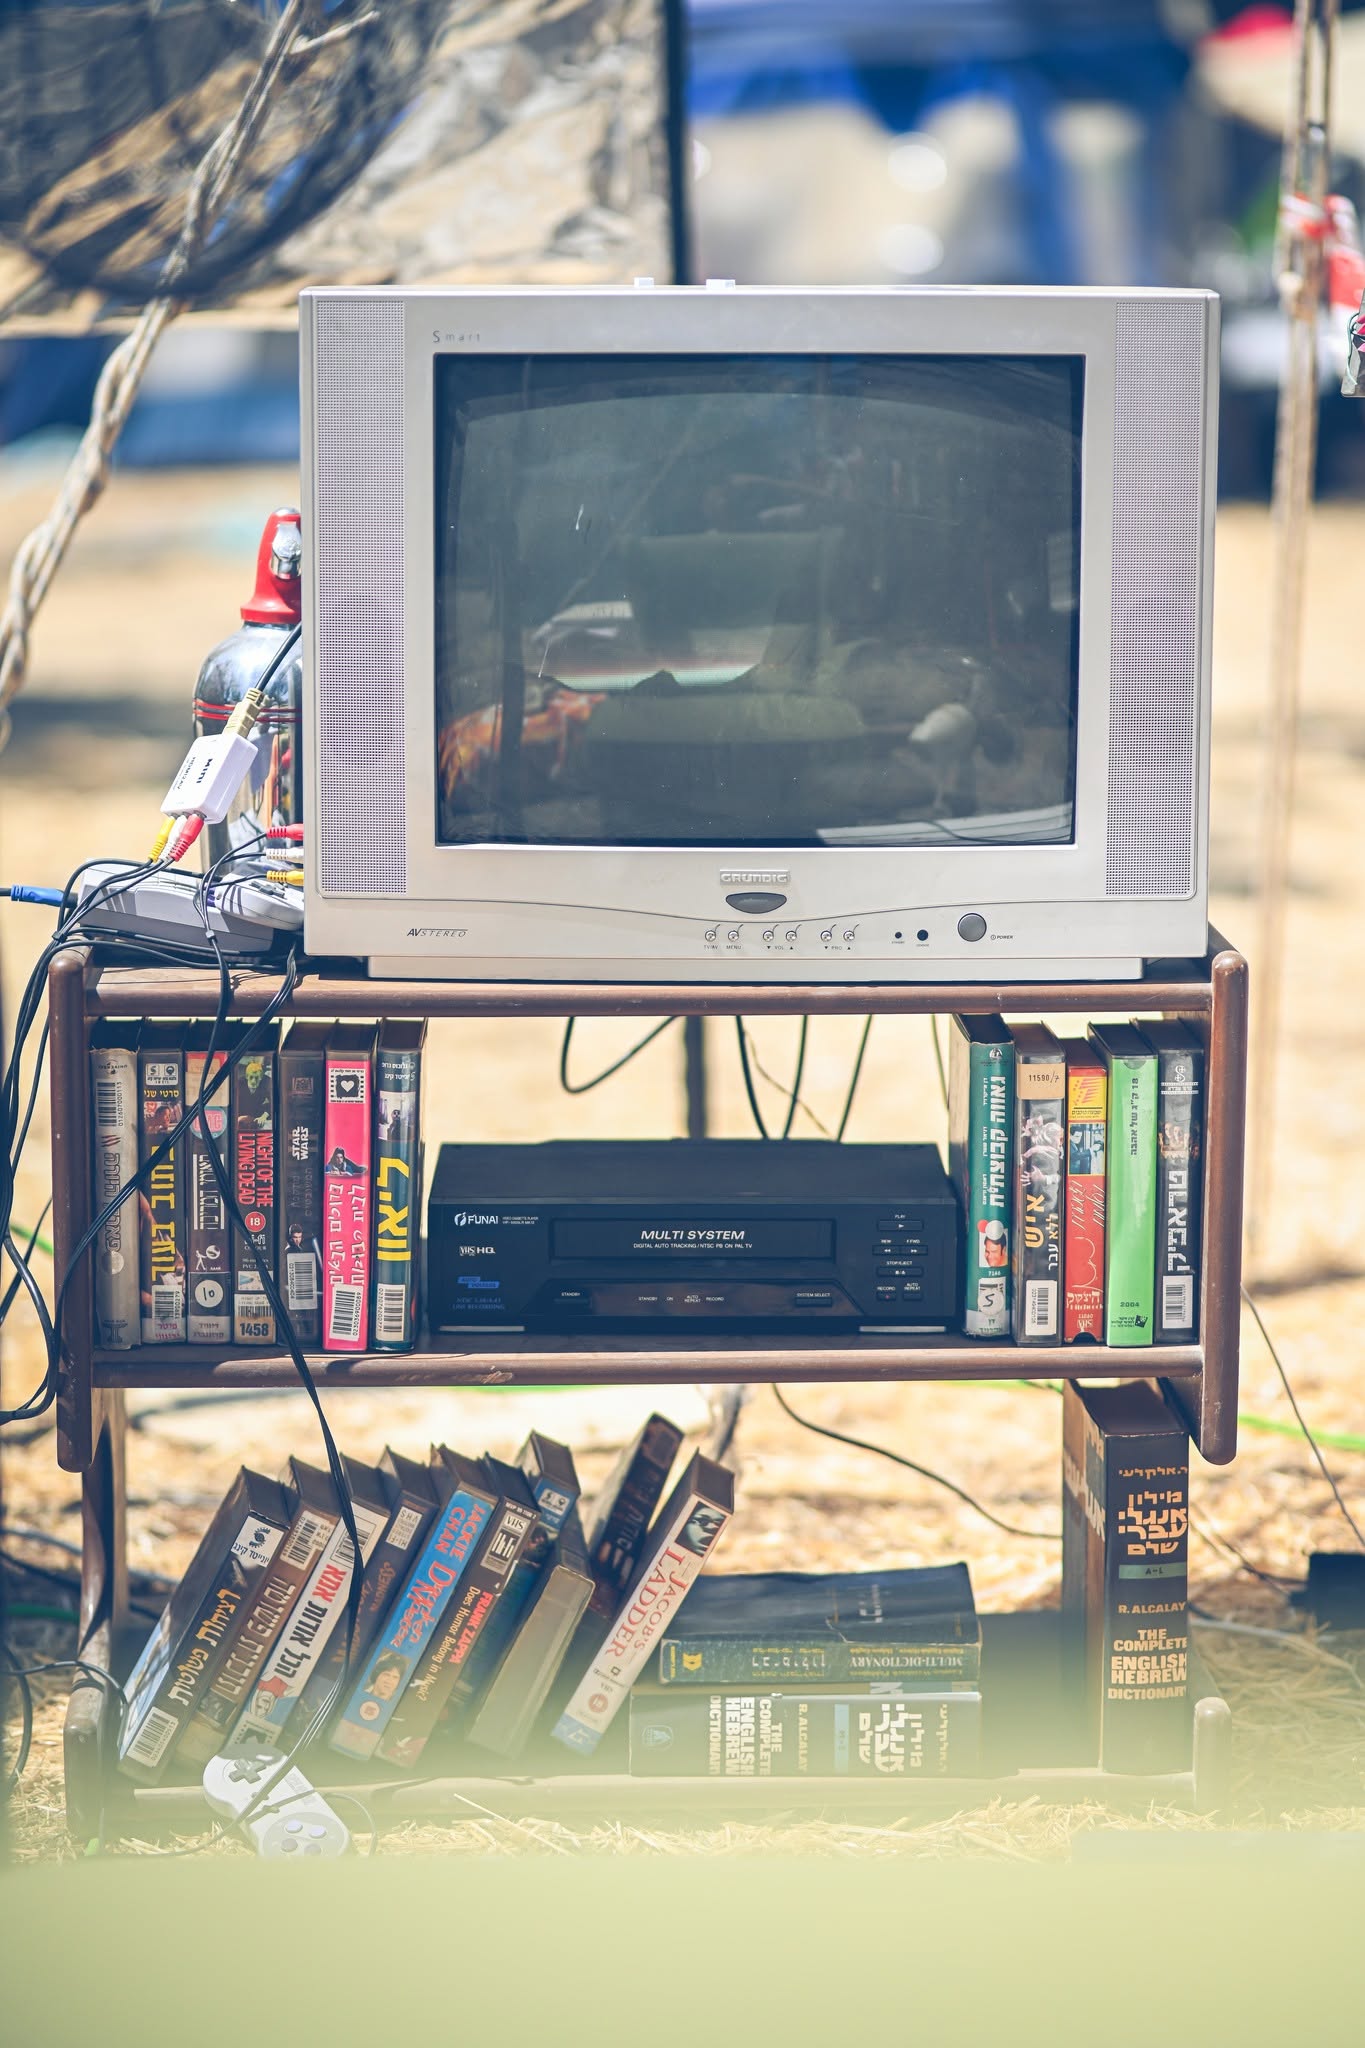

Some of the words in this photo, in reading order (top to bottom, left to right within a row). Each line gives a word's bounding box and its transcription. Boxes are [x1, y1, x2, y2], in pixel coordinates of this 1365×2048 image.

[720, 872, 788, 884] GRUNDIG
[143, 1089, 157, 1098] שני
[160, 1089, 180, 1098] סרטי
[1131, 1077, 1139, 1090] 18
[989, 1075, 1007, 1123] גאווה
[1129, 1112, 1138, 1127] של
[238, 1132, 255, 1170] LIVING
[257, 1132, 273, 1168] NIGHT
[291, 1125, 301, 1161] STAR
[300, 1126, 309, 1161] WARS
[1130, 1129, 1138, 1156] אהבה
[257, 1168, 273, 1183] OF
[988, 1128, 1009, 1208] קבוצתית
[238, 1172, 255, 1205] DEAD
[257, 1186, 273, 1208] THE
[347, 1183, 366, 1222] לבית
[250, 1217, 261, 1226] 18
[327, 1182, 345, 1233] ברוכים
[376, 1156, 412, 1262] ליאון
[467, 1213, 499, 1225] FUNAI
[1024, 1193, 1045, 1248] איש
[1167, 1169, 1191, 1273] טראפיק
[640, 1230, 684, 1241] MULTI
[686, 1230, 746, 1241] SYSTEM
[1045, 1213, 1059, 1240] ללא
[327, 1239, 346, 1285] הבאים
[476, 1246, 496, 1254] HQ
[1048, 1243, 1059, 1271] עבר
[202, 1287, 216, 1302] 10
[240, 1322, 269, 1337] 1458
[1128, 1490, 1183, 1509] מילון
[432, 1506, 466, 1554] CHAN
[504, 1514, 526, 1531] VHS
[1118, 1507, 1188, 1526] אנגלי
[1118, 1522, 1188, 1540] עברי
[450, 1503, 487, 1561] JACKIE
[1127, 1541, 1179, 1556] שלם
[311, 1563, 348, 1604] אמא
[462, 1586, 481, 1606] Does
[466, 1591, 494, 1630] FRANK
[605, 1547, 687, 1658] LADDER
[633, 1574, 687, 1653] JACOB'S
[1131, 1601, 1187, 1614] ALCALAY
[289, 1600, 329, 1649] אודות
[448, 1607, 471, 1636] Humor
[1137, 1628, 1168, 1640] THE
[431, 1635, 457, 1661] Belong
[448, 1627, 477, 1665] ZAPPA
[1113, 1637, 1187, 1652] COMPLETE
[273, 1646, 313, 1679] הכל
[429, 1663, 442, 1673] in
[849, 1655, 964, 1667] MULTI-DICTIONARY
[1111, 1652, 1187, 1670] ENGLISH
[1111, 1667, 1187, 1685] HEBREW
[1107, 1685, 1187, 1700] DICTIONAR
[725, 1697, 741, 1776] HEBREW
[740, 1696, 756, 1776] ENGLISH
[759, 1698, 772, 1776] COMPLETE
[771, 1722, 783, 1753] THE
[798, 1715, 808, 1772] ALCALAY
[858, 1712, 874, 1764] שלם
[874, 1703, 891, 1773] עברי
[890, 1703, 906, 1773] אנגלי
[904, 1712, 926, 1769] מילון
